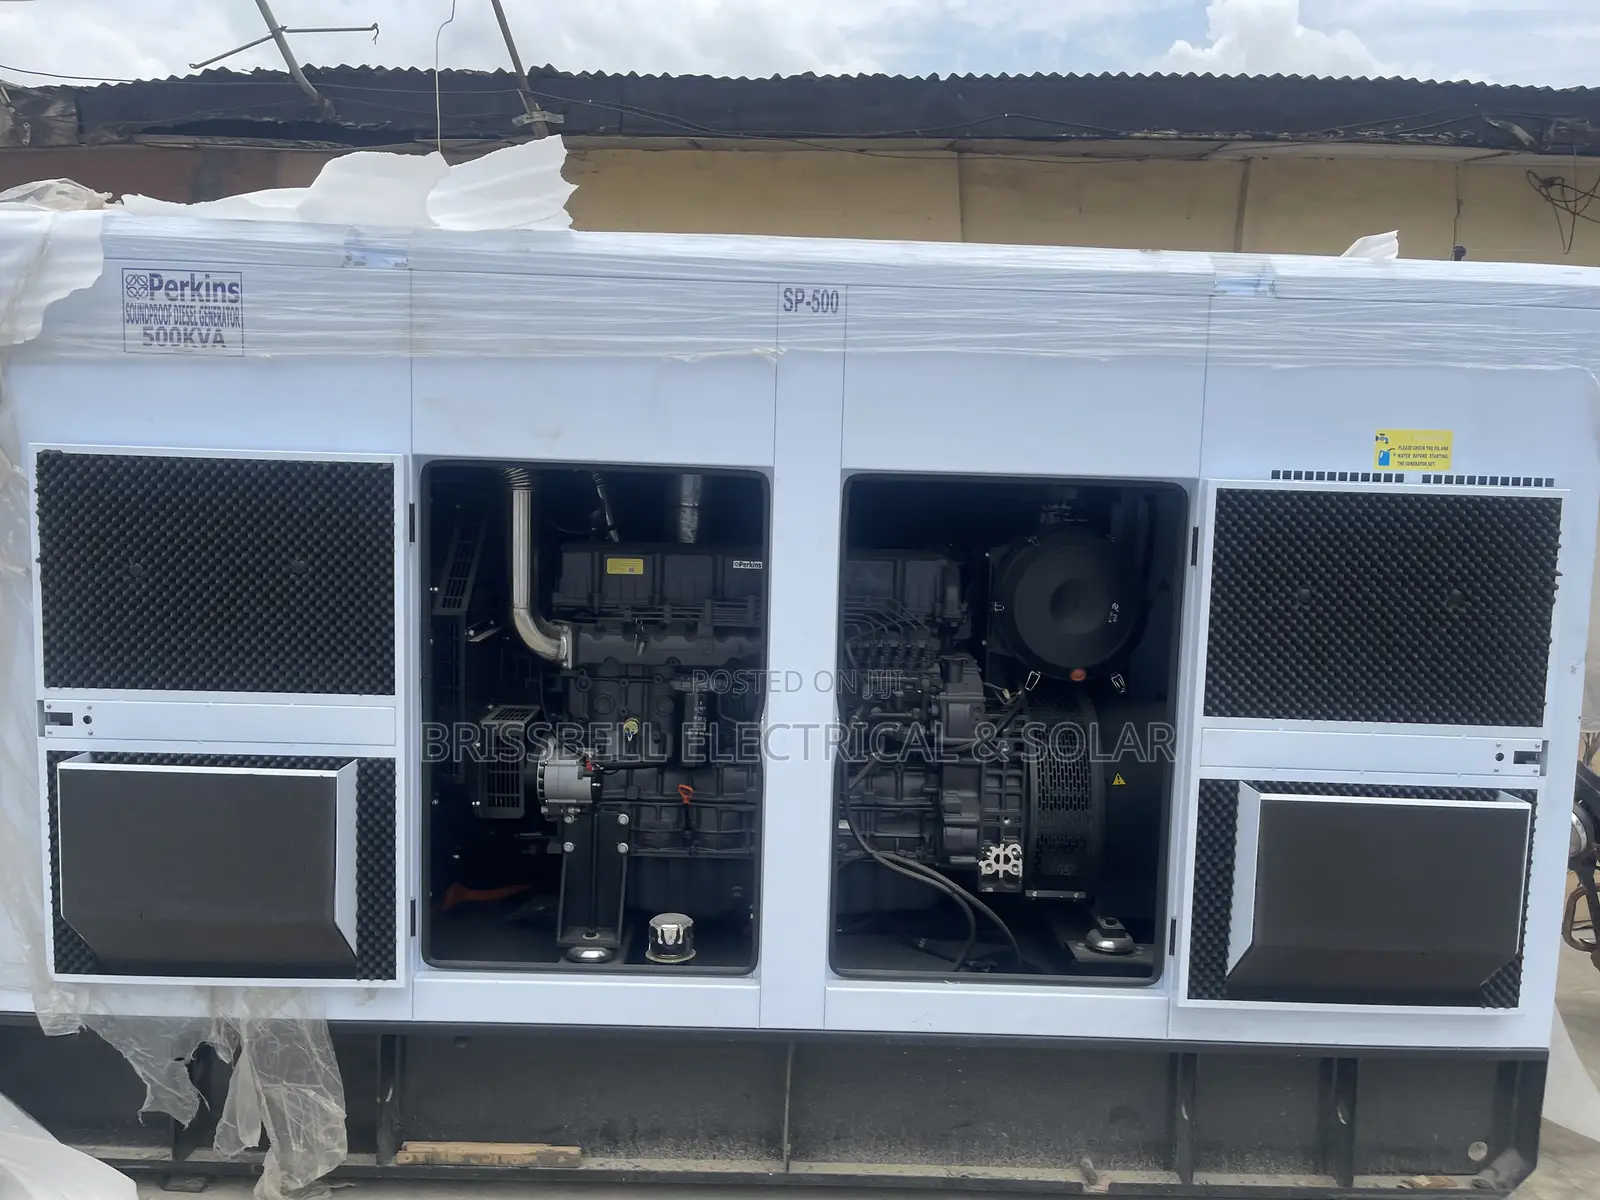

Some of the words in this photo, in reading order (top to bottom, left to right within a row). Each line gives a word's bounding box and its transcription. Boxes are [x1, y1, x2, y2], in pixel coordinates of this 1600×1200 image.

[149, 273, 240, 303] Perkins
[783, 287, 839, 314] SP-500
[125, 302, 172, 326] SOUNDPROOF
[173, 304, 198, 327] DIESEL
[199, 305, 241, 329] GENERATOR
[142, 326, 226, 348] 500KVA
